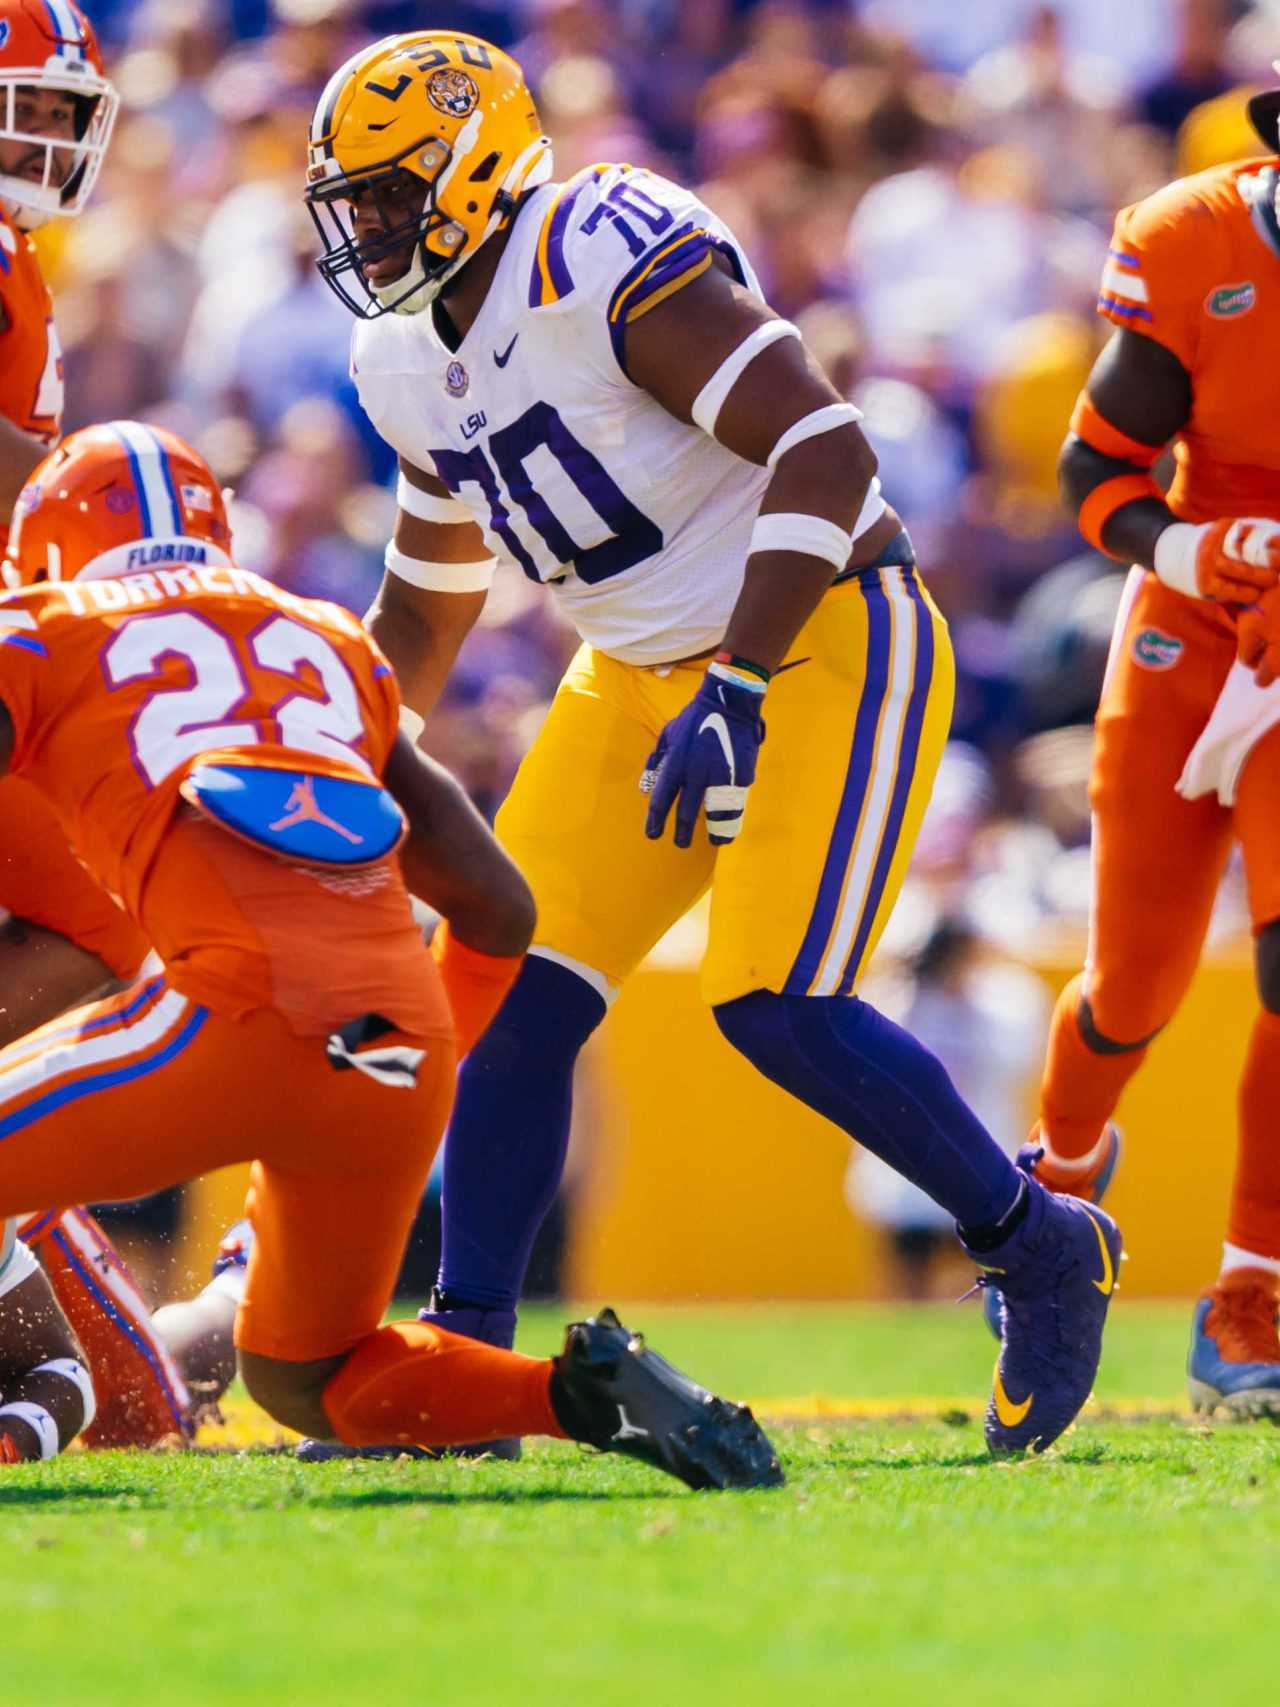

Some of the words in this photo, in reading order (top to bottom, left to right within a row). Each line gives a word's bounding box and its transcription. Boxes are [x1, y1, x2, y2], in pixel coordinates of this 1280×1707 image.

[365, 40, 492, 102] LSU
[579, 181, 678, 259] 70
[460, 409, 487, 440] LSU
[428, 400, 663, 584] 70
[127, 543, 207, 569] FLORIDA
[99, 607, 382, 790] 22
